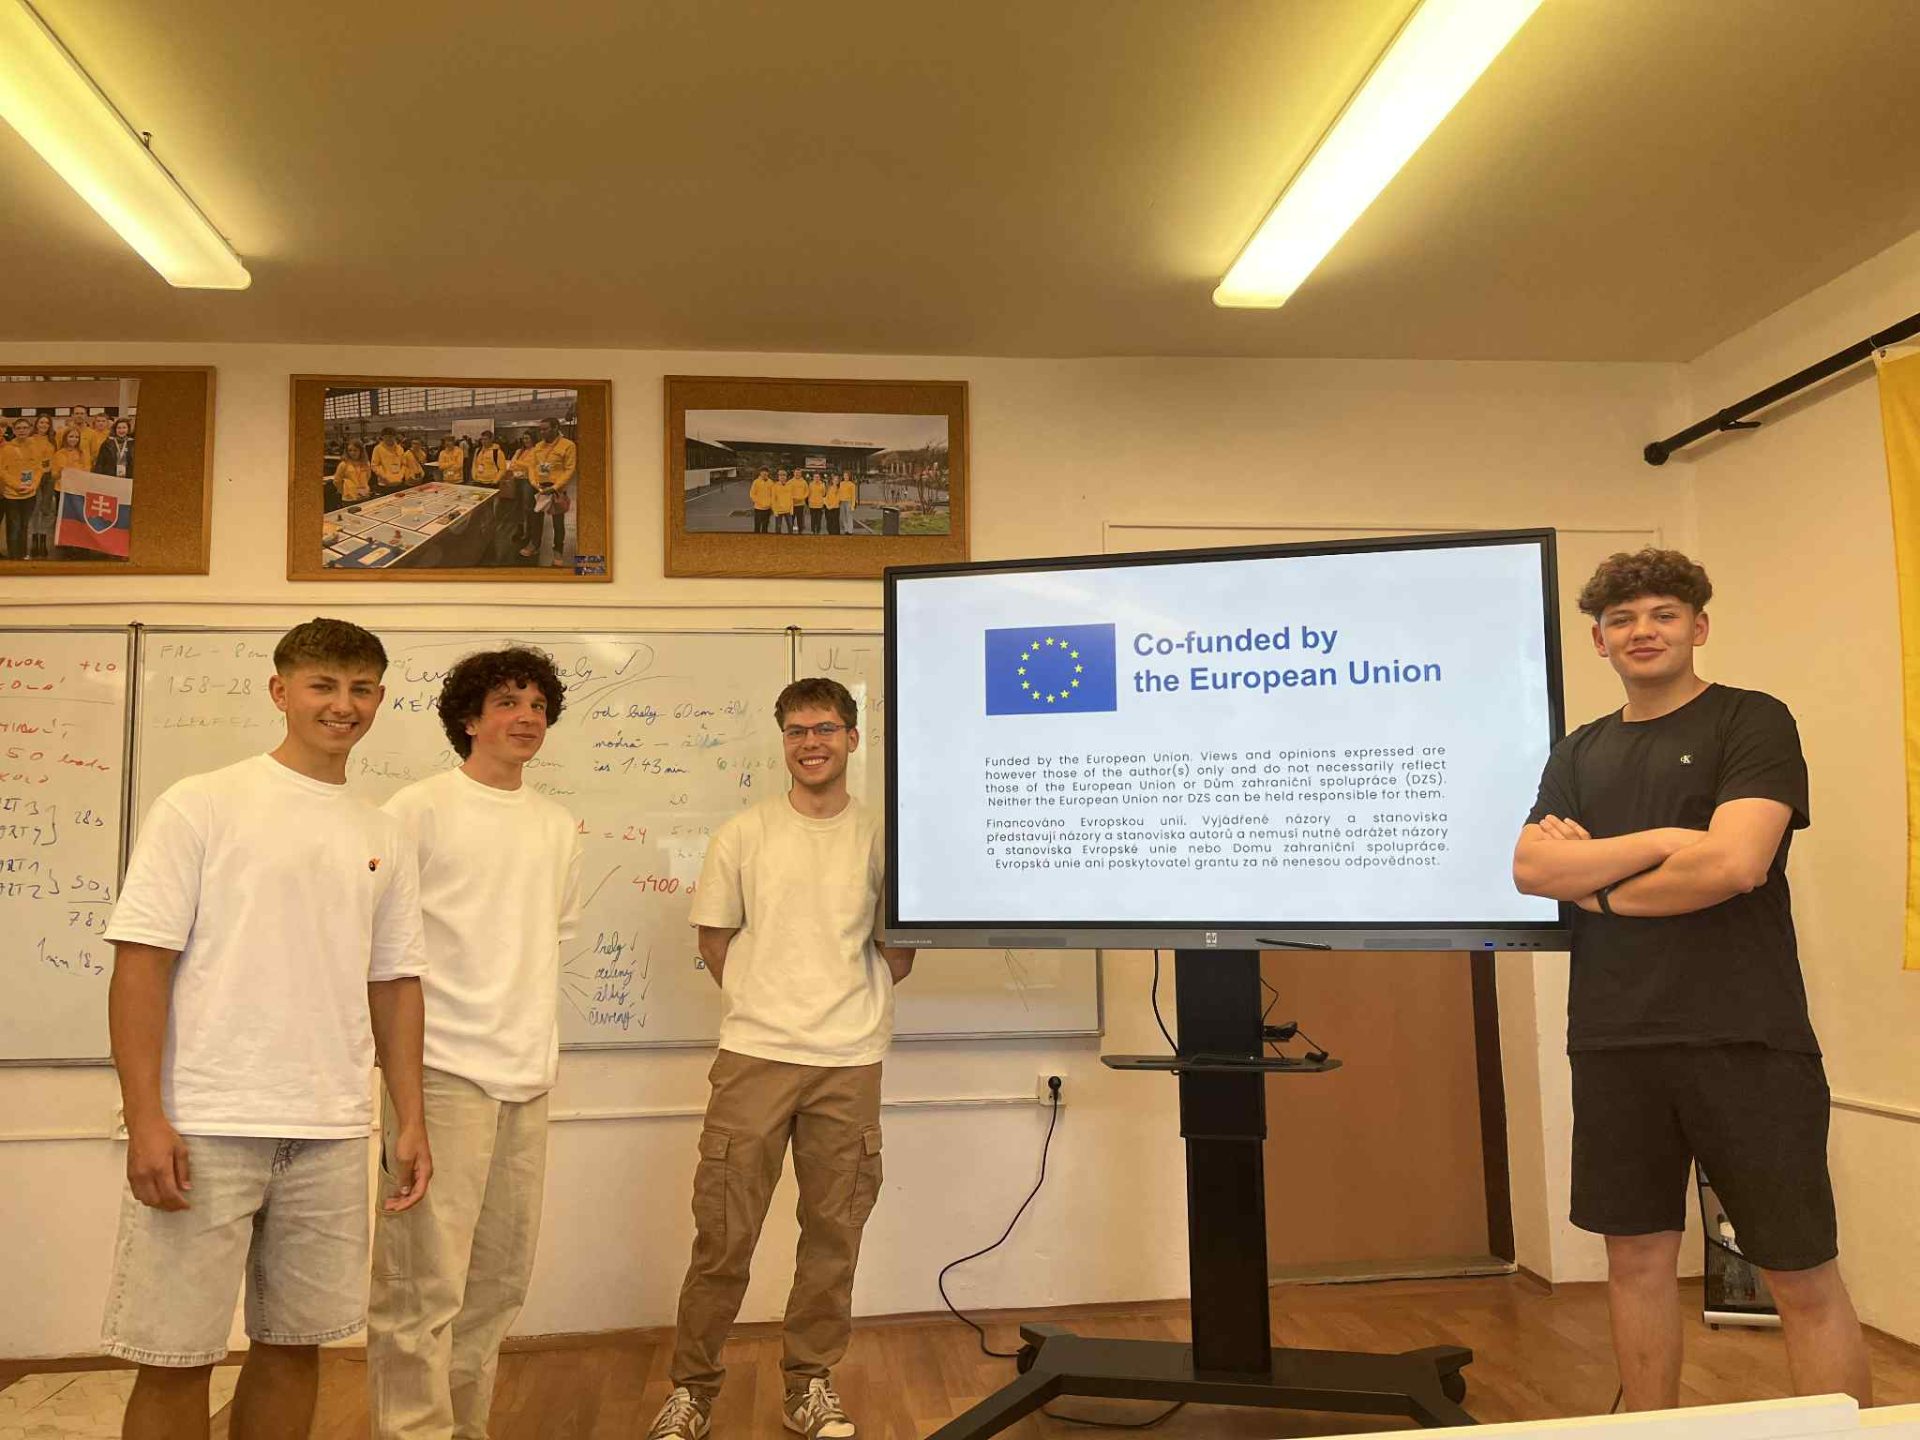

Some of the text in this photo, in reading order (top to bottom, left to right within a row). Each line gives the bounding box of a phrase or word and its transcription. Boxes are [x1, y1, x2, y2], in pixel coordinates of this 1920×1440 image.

[1133, 626, 1338, 656] Co-funded by
[1133, 658, 1442, 695] the European Union
[985, 746, 1446, 767] Funded by the European Union. Views and opinions expressed are
[986, 760, 1446, 779] however those of the author(s) only and do not necessarily reflect
[986, 772, 1447, 793] those of the European Union or Dům zahraniční spolupráce (DZS).
[988, 789, 1444, 806] Neither the European Union nor DZS can be held responsible for them.
[987, 819, 1065, 829] Financováno
[1081, 818, 1144, 829] Evropskou
[1160, 817, 1186, 826] unií.
[1202, 816, 1269, 828] Vyjádřené
[1286, 814, 1331, 826] názory
[1373, 812, 1447, 823] stanoviska
[987, 832, 1056, 843] představují
[1059, 832, 1100, 843] názory
[1117, 830, 1185, 840] stanoviska
[1190, 830, 1233, 839] autorů
[1237, 830, 1245, 839] a
[1250, 828, 1297, 839] nemusí
[1302, 828, 1340, 838] nutně
[1346, 827, 1398, 838] odrážet
[1402, 826, 1448, 838] názory
[1005, 845, 1071, 855] stanoviska
[1083, 844, 1137, 856] Evropské
[1150, 845, 1176, 853] unie
[1189, 844, 1221, 853] nebo
[1233, 843, 1271, 853] Domu
[1284, 842, 1355, 853] zahraniční
[1367, 840, 1449, 853] spolupráce.
[996, 855, 1439, 870] Evropská unie ani poskytovatel grantu za ně nenesou odpovědnost.
